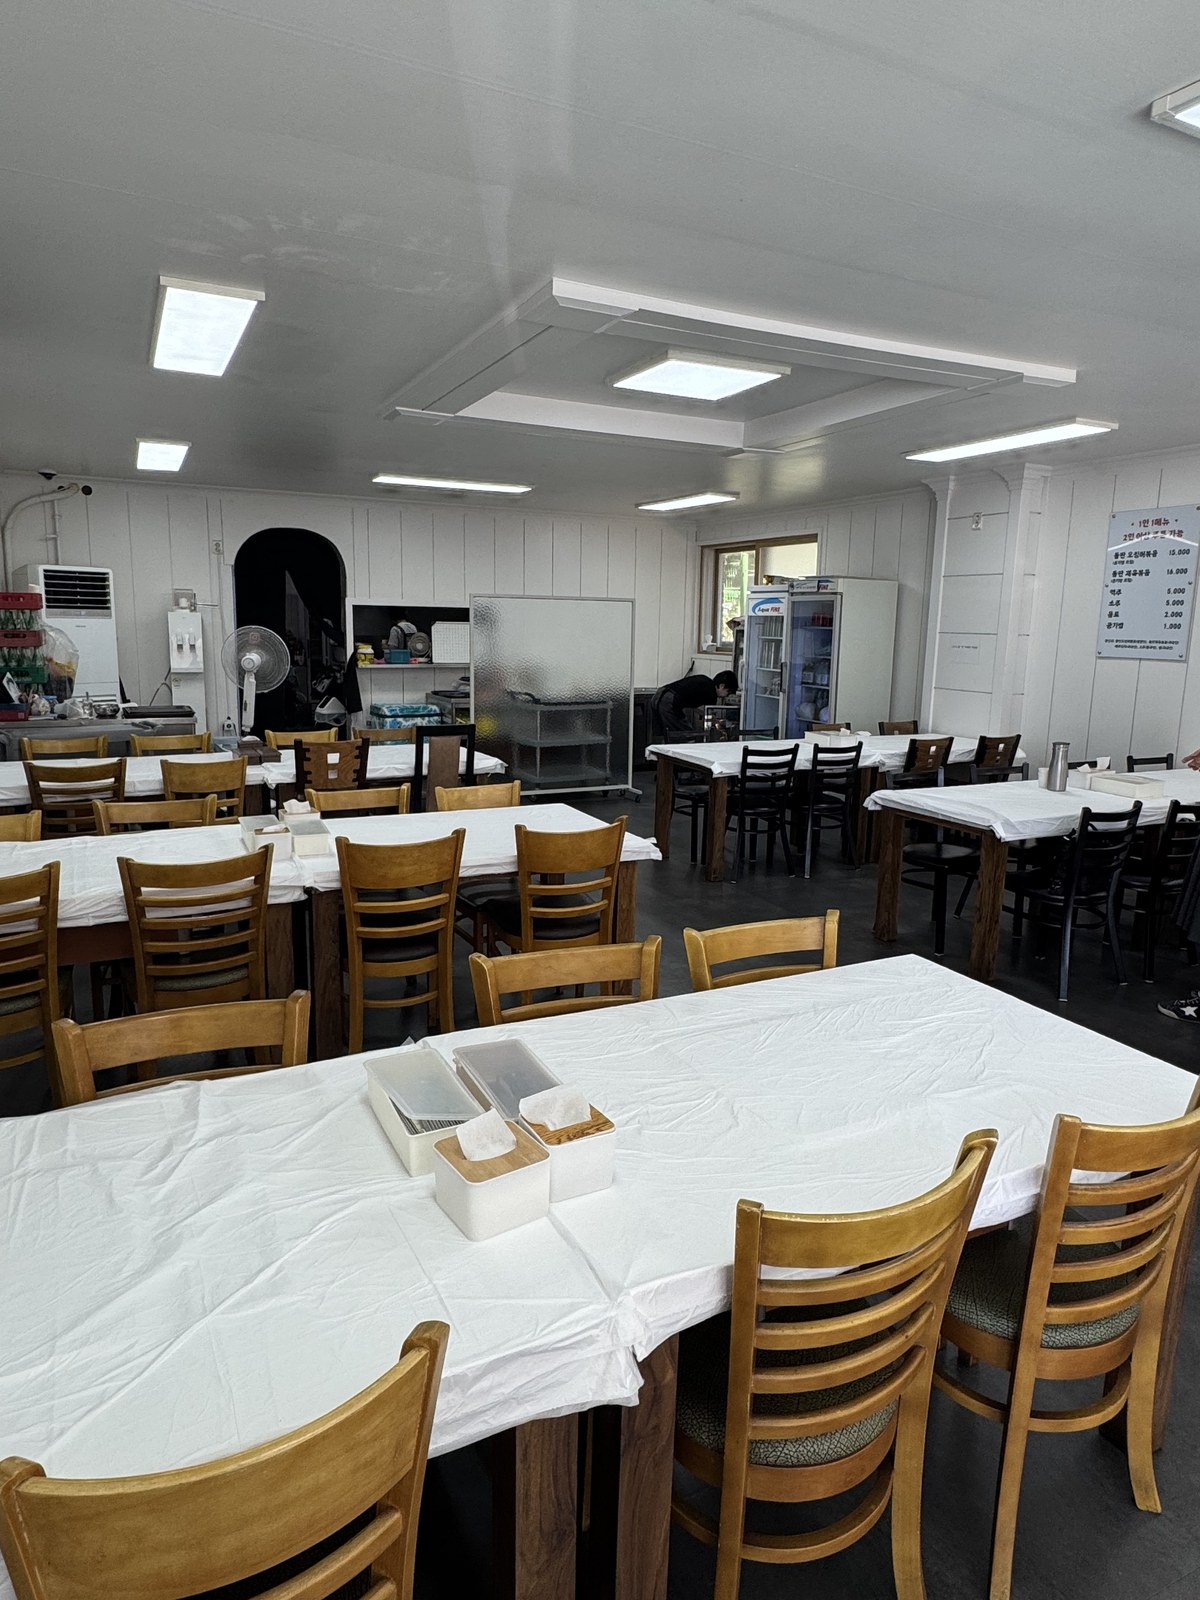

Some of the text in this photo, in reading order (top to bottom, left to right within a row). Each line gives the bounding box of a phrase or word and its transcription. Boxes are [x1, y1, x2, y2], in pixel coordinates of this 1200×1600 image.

[1138, 517, 1170, 528] 1인 1메뉴
[1123, 533, 1135, 541] 2인
[1168, 529, 1184, 538] 가능
[1127, 549, 1158, 559] 오징어볶음
[1125, 568, 1151, 577] 제육볶음
[1109, 588, 1122, 596] 맥주
[1108, 599, 1121, 607] 소주
